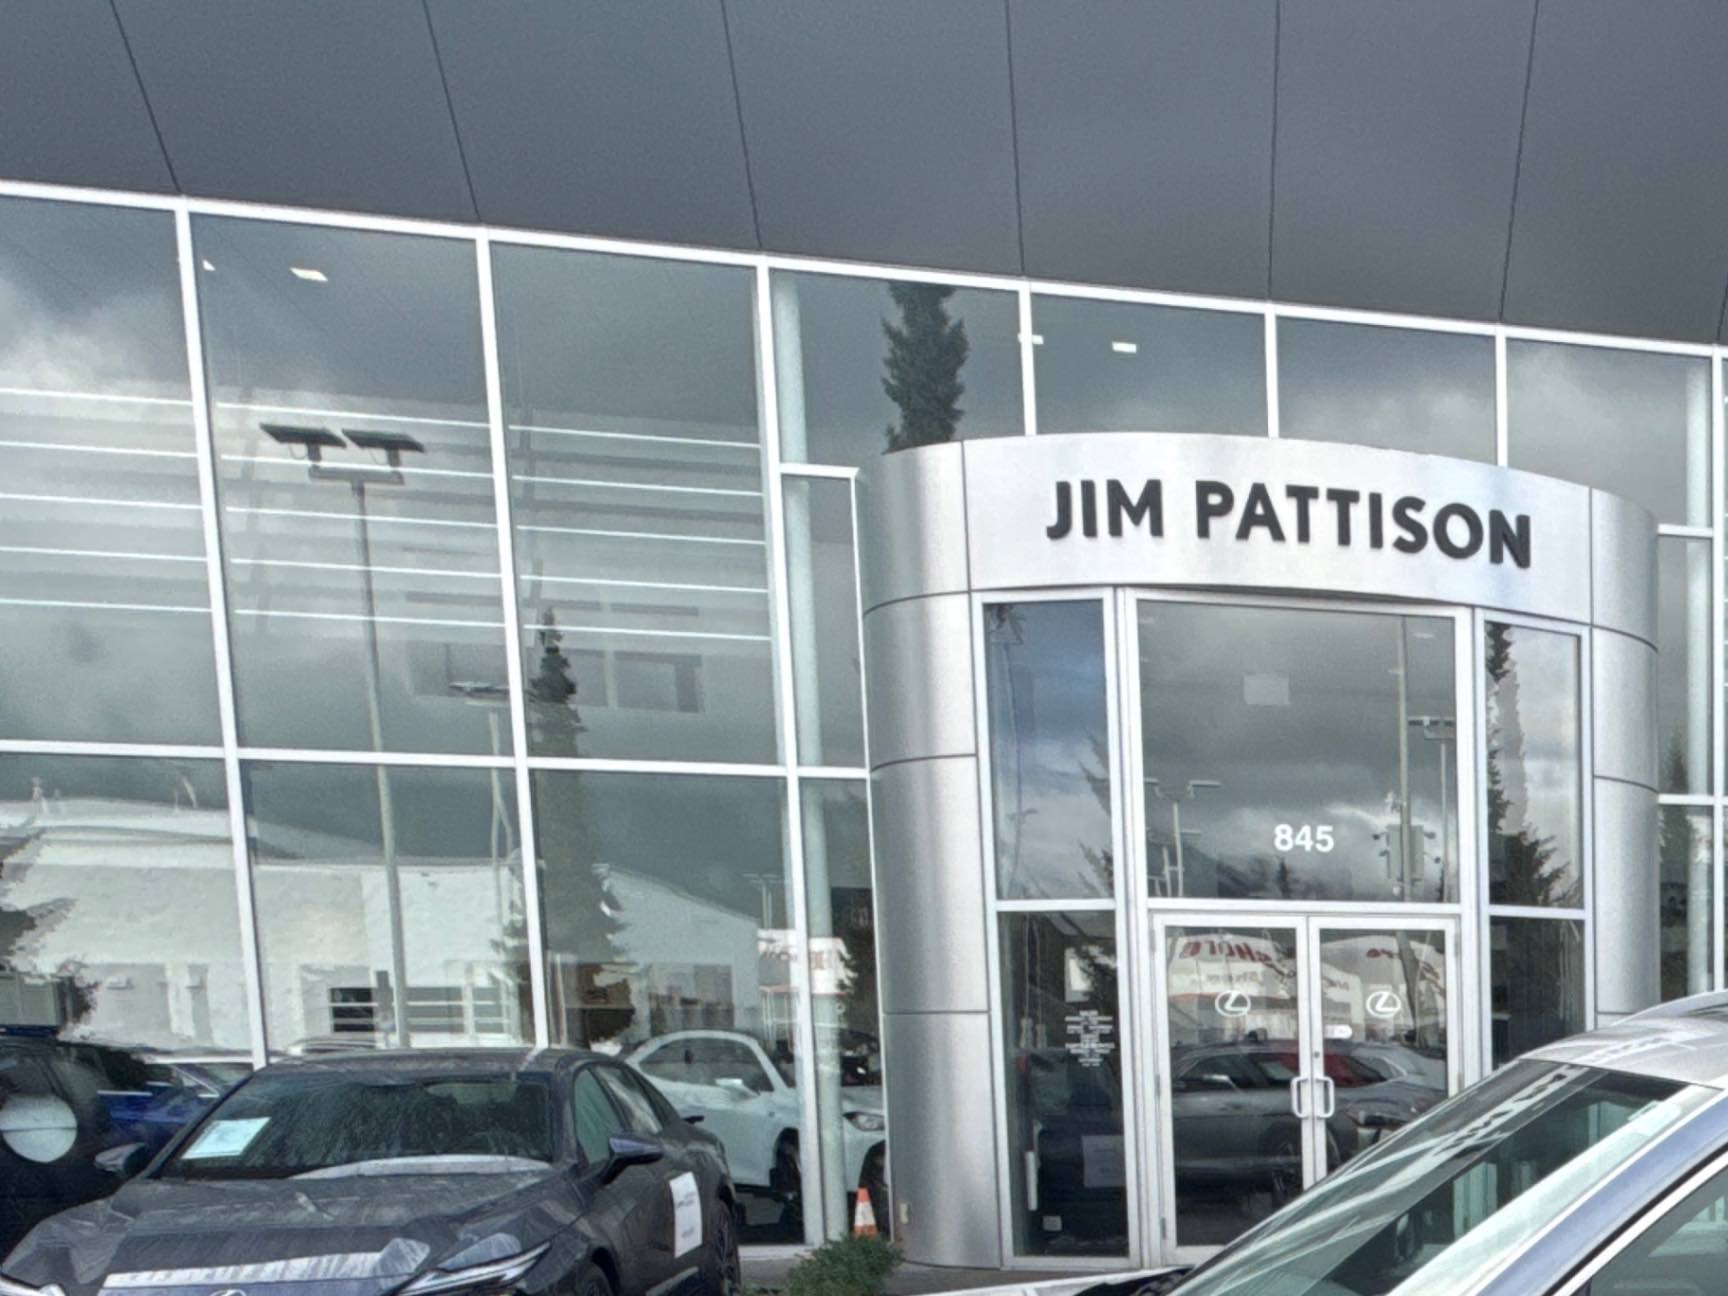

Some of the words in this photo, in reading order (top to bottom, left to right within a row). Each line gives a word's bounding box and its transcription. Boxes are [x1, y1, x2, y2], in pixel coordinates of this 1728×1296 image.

[1046, 479, 1164, 540] JIM
[1195, 480, 1531, 569] PATTISON
[1274, 823, 1335, 853] 845
